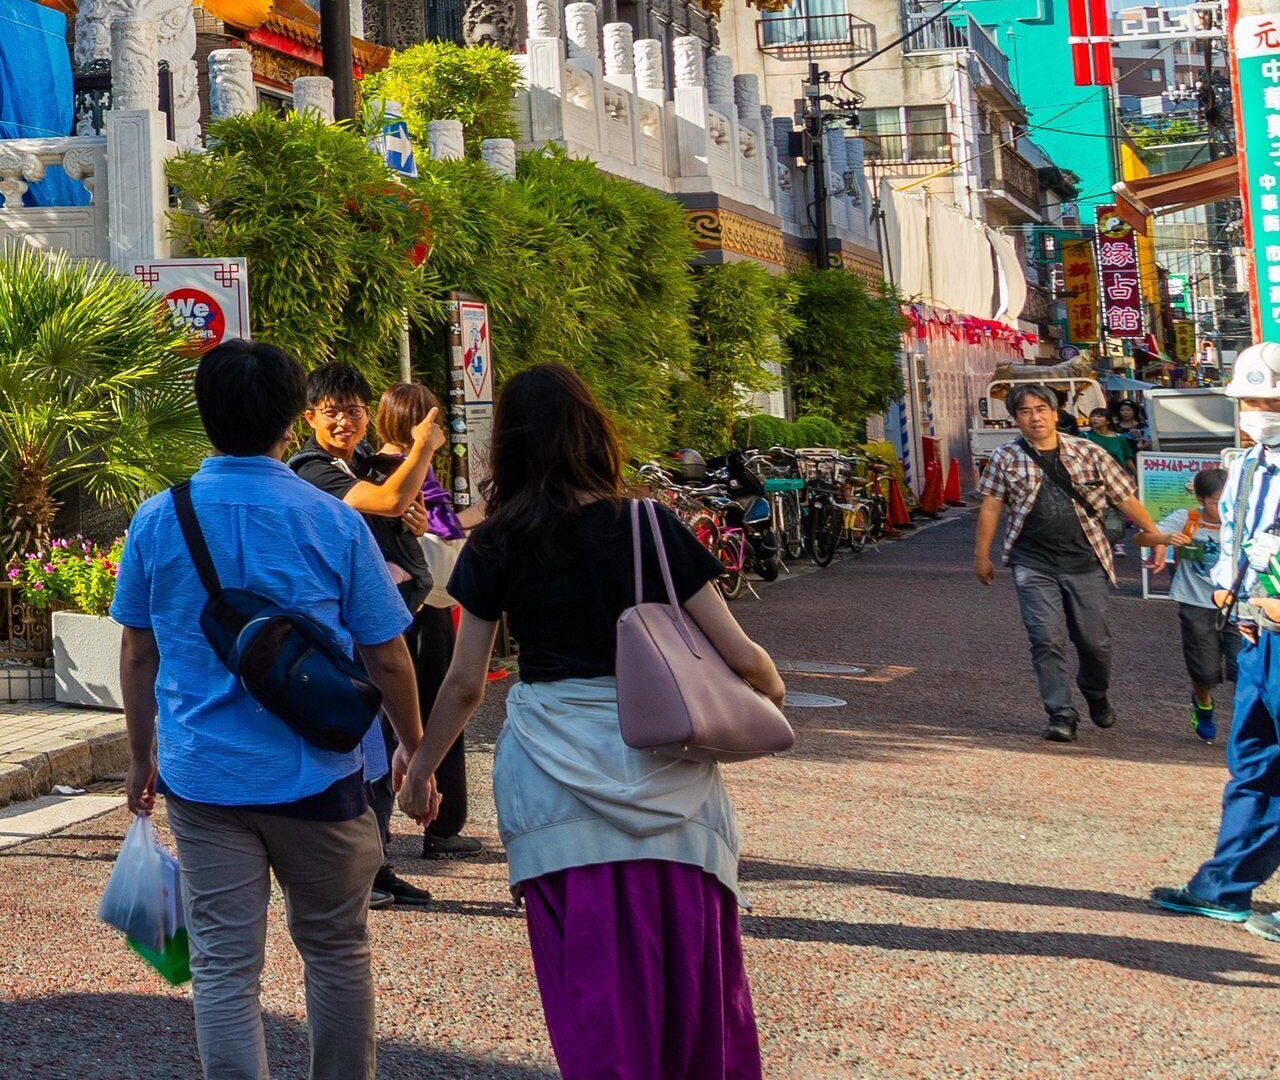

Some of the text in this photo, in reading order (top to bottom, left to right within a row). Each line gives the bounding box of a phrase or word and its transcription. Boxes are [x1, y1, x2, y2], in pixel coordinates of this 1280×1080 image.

[166, 298, 209, 317] We
[1101, 242, 1140, 331] 縁占館
